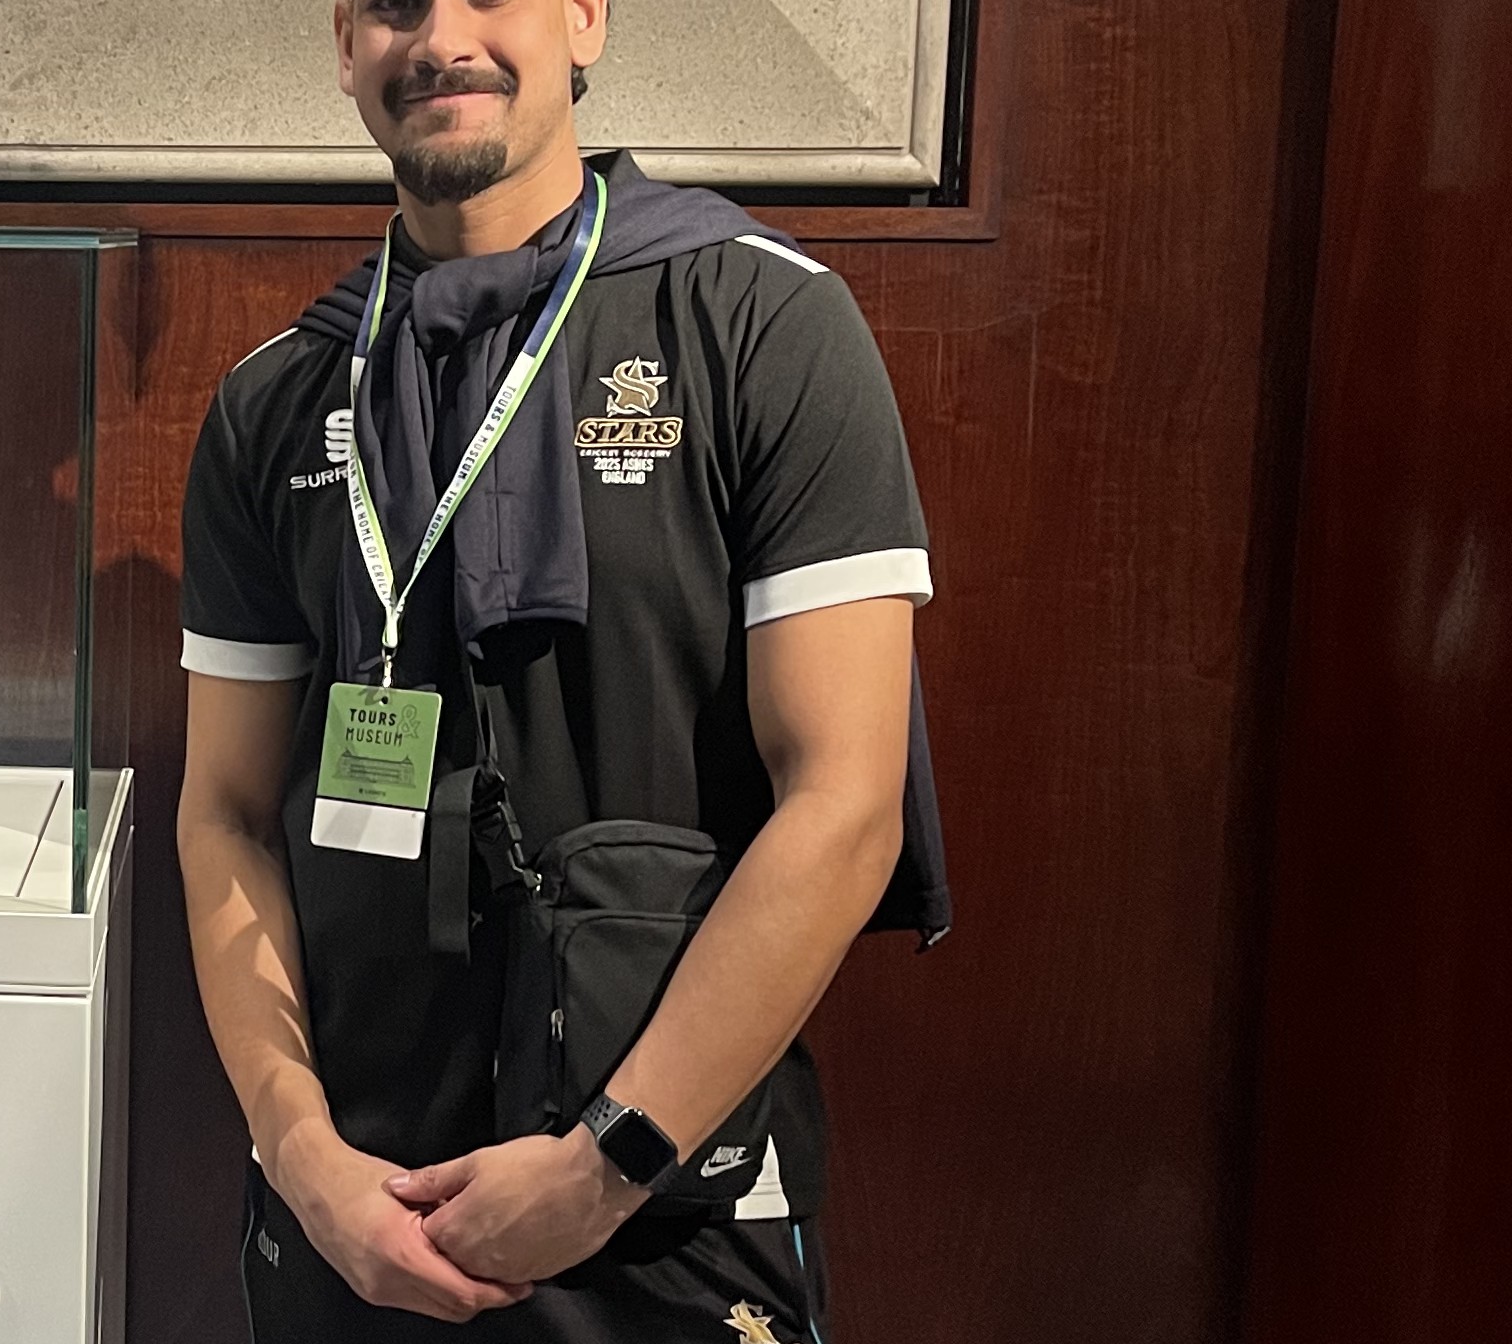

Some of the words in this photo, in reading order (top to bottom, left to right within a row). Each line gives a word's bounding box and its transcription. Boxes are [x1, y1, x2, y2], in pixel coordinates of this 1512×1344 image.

[491, 384, 517, 422] TOURS
[579, 421, 678, 444] STARS
[457, 435, 488, 480] MUSEUM
[593, 457, 621, 471] 2025
[621, 458, 655, 472] ASHES
[290, 465, 349, 490] SURR
[352, 484, 364, 510] THE
[440, 489, 458, 512] THE
[357, 512, 375, 544] HOME
[366, 545, 380, 560] OF
[349, 707, 398, 727] TOURS
[345, 726, 404, 747] MUSEUM
[710, 1146, 747, 1163] NIKE
